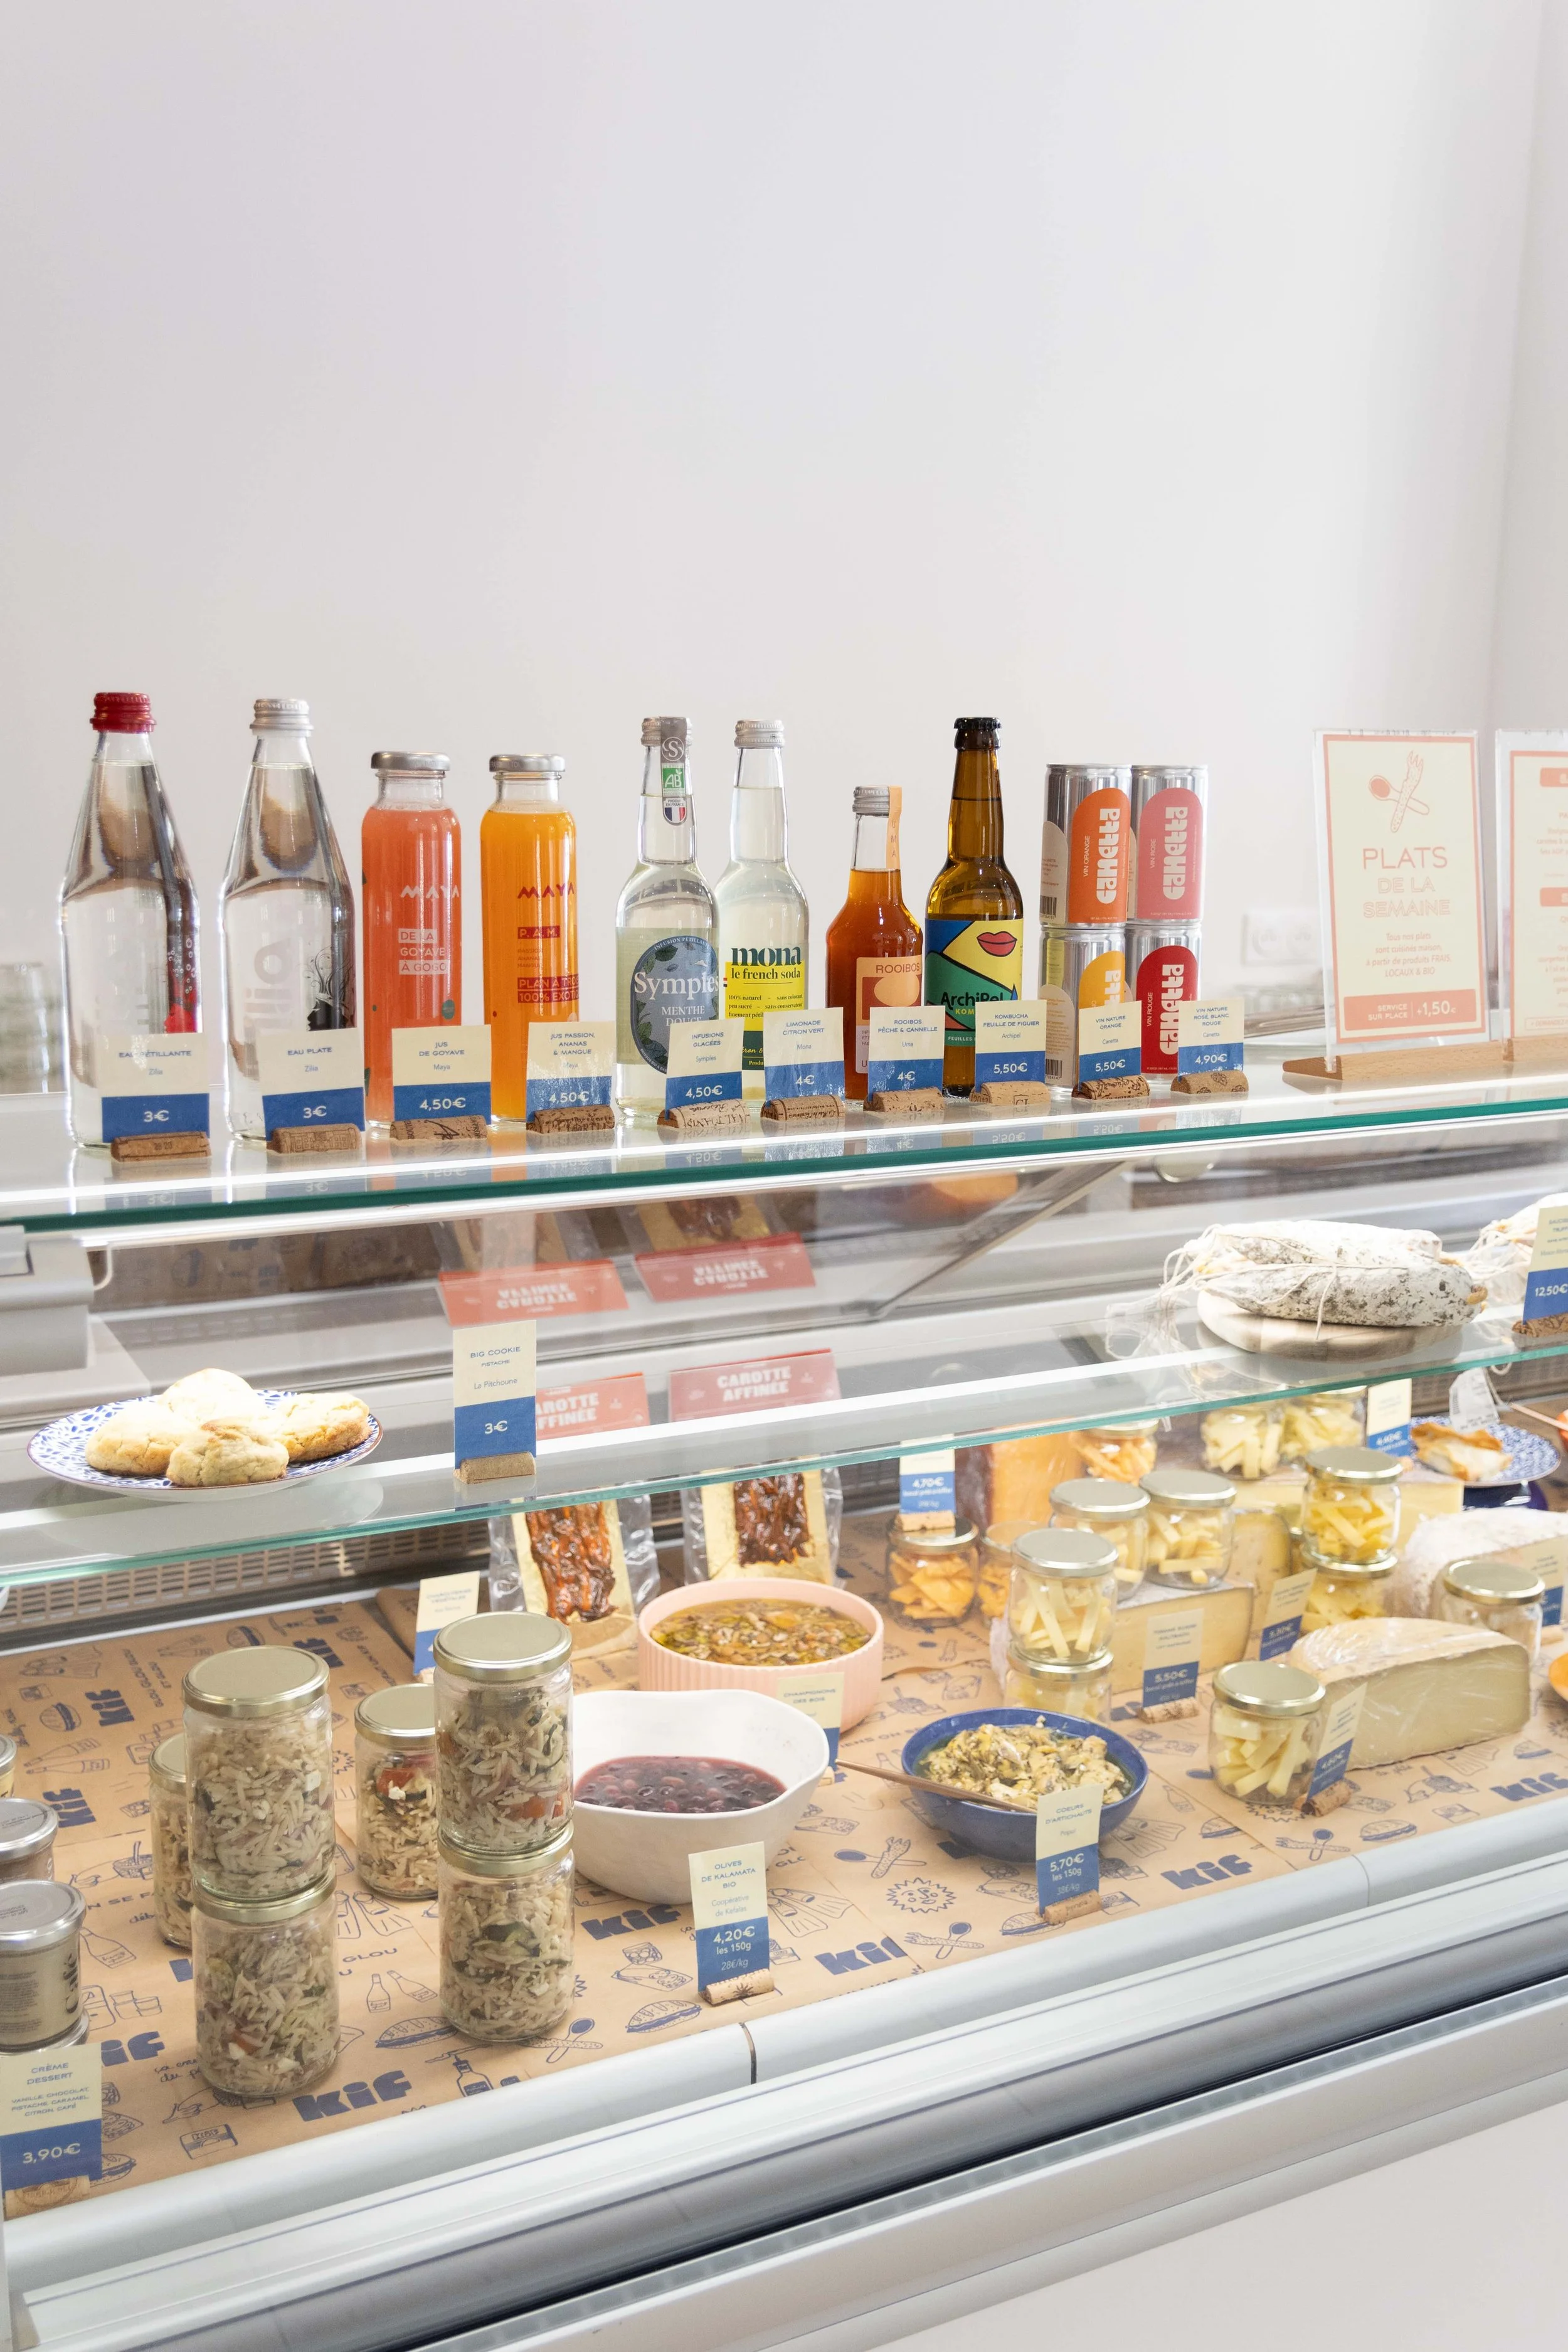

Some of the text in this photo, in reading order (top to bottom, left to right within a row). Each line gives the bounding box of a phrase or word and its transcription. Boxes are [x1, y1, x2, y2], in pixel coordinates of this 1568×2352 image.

[665, 774, 682, 788] AB
[1362, 846, 1448, 870] PLATS
[517, 882, 575, 899] MAYA
[1377, 876, 1436, 894] DE LA
[400, 885, 460, 899] MAYA
[1362, 899, 1451, 918] SEMAINE
[401, 931, 434, 940] DE LA
[1386, 933, 1400, 941] Tous
[1415, 931, 1431, 942] plats
[654, 937, 681, 950] INFUSION
[400, 947, 446, 956] GOYAVE
[1375, 946, 1389, 954] sont
[731, 946, 802, 967] mona
[1372, 955, 1429, 967] partir de produits
[401, 961, 447, 972] À GOGO
[876, 962, 920, 974] ROOIBOS
[1384, 967, 1436, 977] LOCAUX BIO
[731, 967, 800, 980] le french soda
[519, 979, 549, 988] PLAN
[634, 972, 719, 1000] Symples
[519, 993, 549, 1002] 100%
[662, 1005, 705, 1015] MENTHE
[1377, 1004, 1407, 1012] SERVICE
[1368, 1011, 1407, 1021] SUR PLACE
[692, 1039, 721, 1047] GLACÉES
[139, 1049, 192, 1058] PÉTILLANTE
[696, 1055, 716, 1063] Symples
[1194, 1053, 1228, 1065] 4,90€
[993, 1062, 1028, 1075] 5,50€
[1095, 1059, 1126, 1073] 5,50€
[795, 1074, 815, 1085] 4€
[897, 1071, 915, 1081] 4€
[549, 1091, 590, 1104] 4,50€
[686, 1084, 723, 1099] 4,50€
[419, 1097, 467, 1112] 4,50€
[143, 1110, 169, 1122] 3€
[303, 1106, 327, 1119] 3€
[487, 1346, 521, 1356] COOKIE
[481, 1359, 511, 1367] PISTACHE
[484, 1377, 517, 1388] Pitchoune
[717, 1365, 792, 1389] CAROTTE
[723, 1380, 789, 1402] AFFINÉE
[536, 1392, 599, 1415] AROTTE
[484, 1419, 508, 1434] 3€
[783, 1688, 837, 1697] CHAMPIGNONS
[1056, 1803, 1084, 1814] COEURS
[1045, 1808, 1093, 1825] D'ARTICHAUTS
[714, 1860, 743, 1870] OLIVES
[1050, 1853, 1084, 1872] 5,70€
[714, 1868, 756, 1880] KALAMATA
[1052, 1867, 1082, 1882] les 150g
[723, 1881, 736, 1889] BIO
[711, 1894, 750, 1907] Coopérative
[715, 1905, 747, 1917] de Kefalas
[713, 1926, 756, 1944] 4,20€
[716, 1942, 752, 1955] les 150g
[342, 1947, 398, 1963] GLOU
[721, 1958, 748, 1971] 28€/kg
[31, 2062, 69, 2074] CRÈME
[26, 2072, 73, 2085] DESSERT
[56, 2102, 77, 2112] CAFÉ
[22, 2143, 81, 2164] 3,90€
